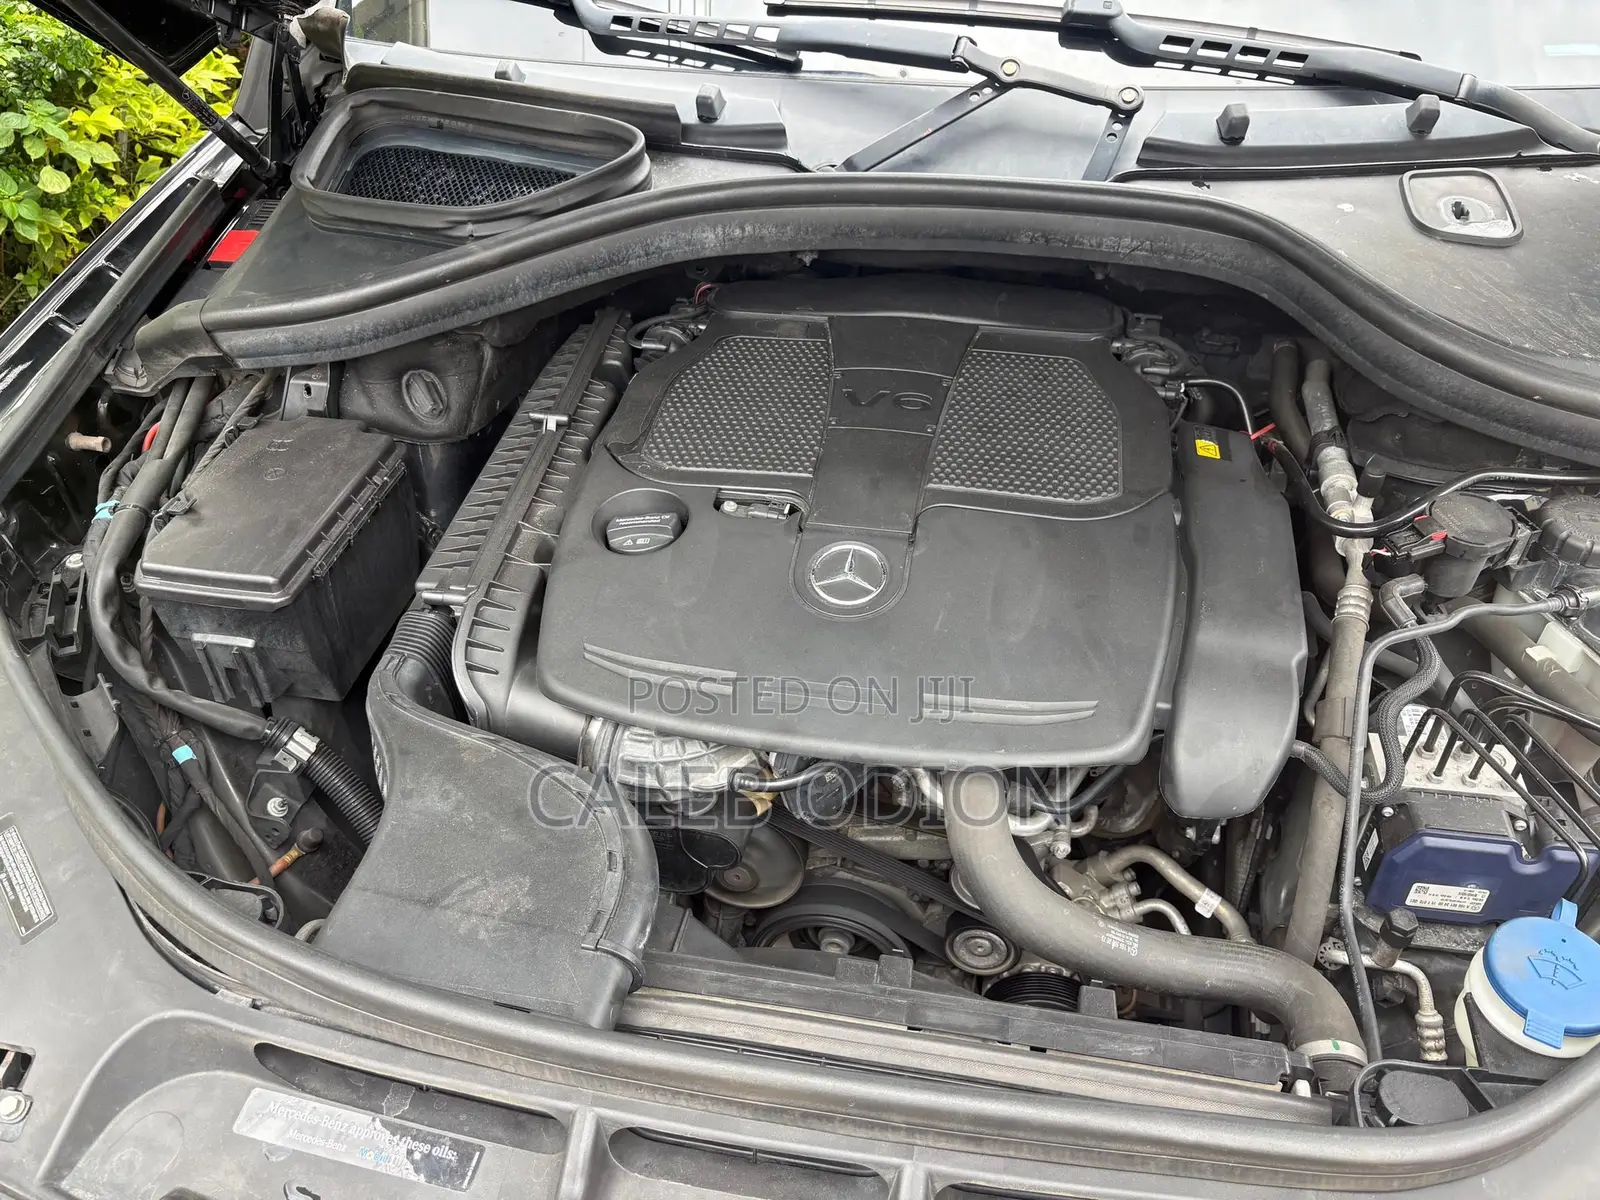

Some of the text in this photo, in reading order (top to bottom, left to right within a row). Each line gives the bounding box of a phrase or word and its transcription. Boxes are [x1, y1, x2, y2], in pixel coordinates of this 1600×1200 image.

[842, 388, 933, 410] V6
[268, 1101, 348, 1130] Mercedes-Benz
[348, 1123, 399, 1147] approves
[400, 1135, 432, 1153] these
[288, 1128, 348, 1153] Mercedes-Benz
